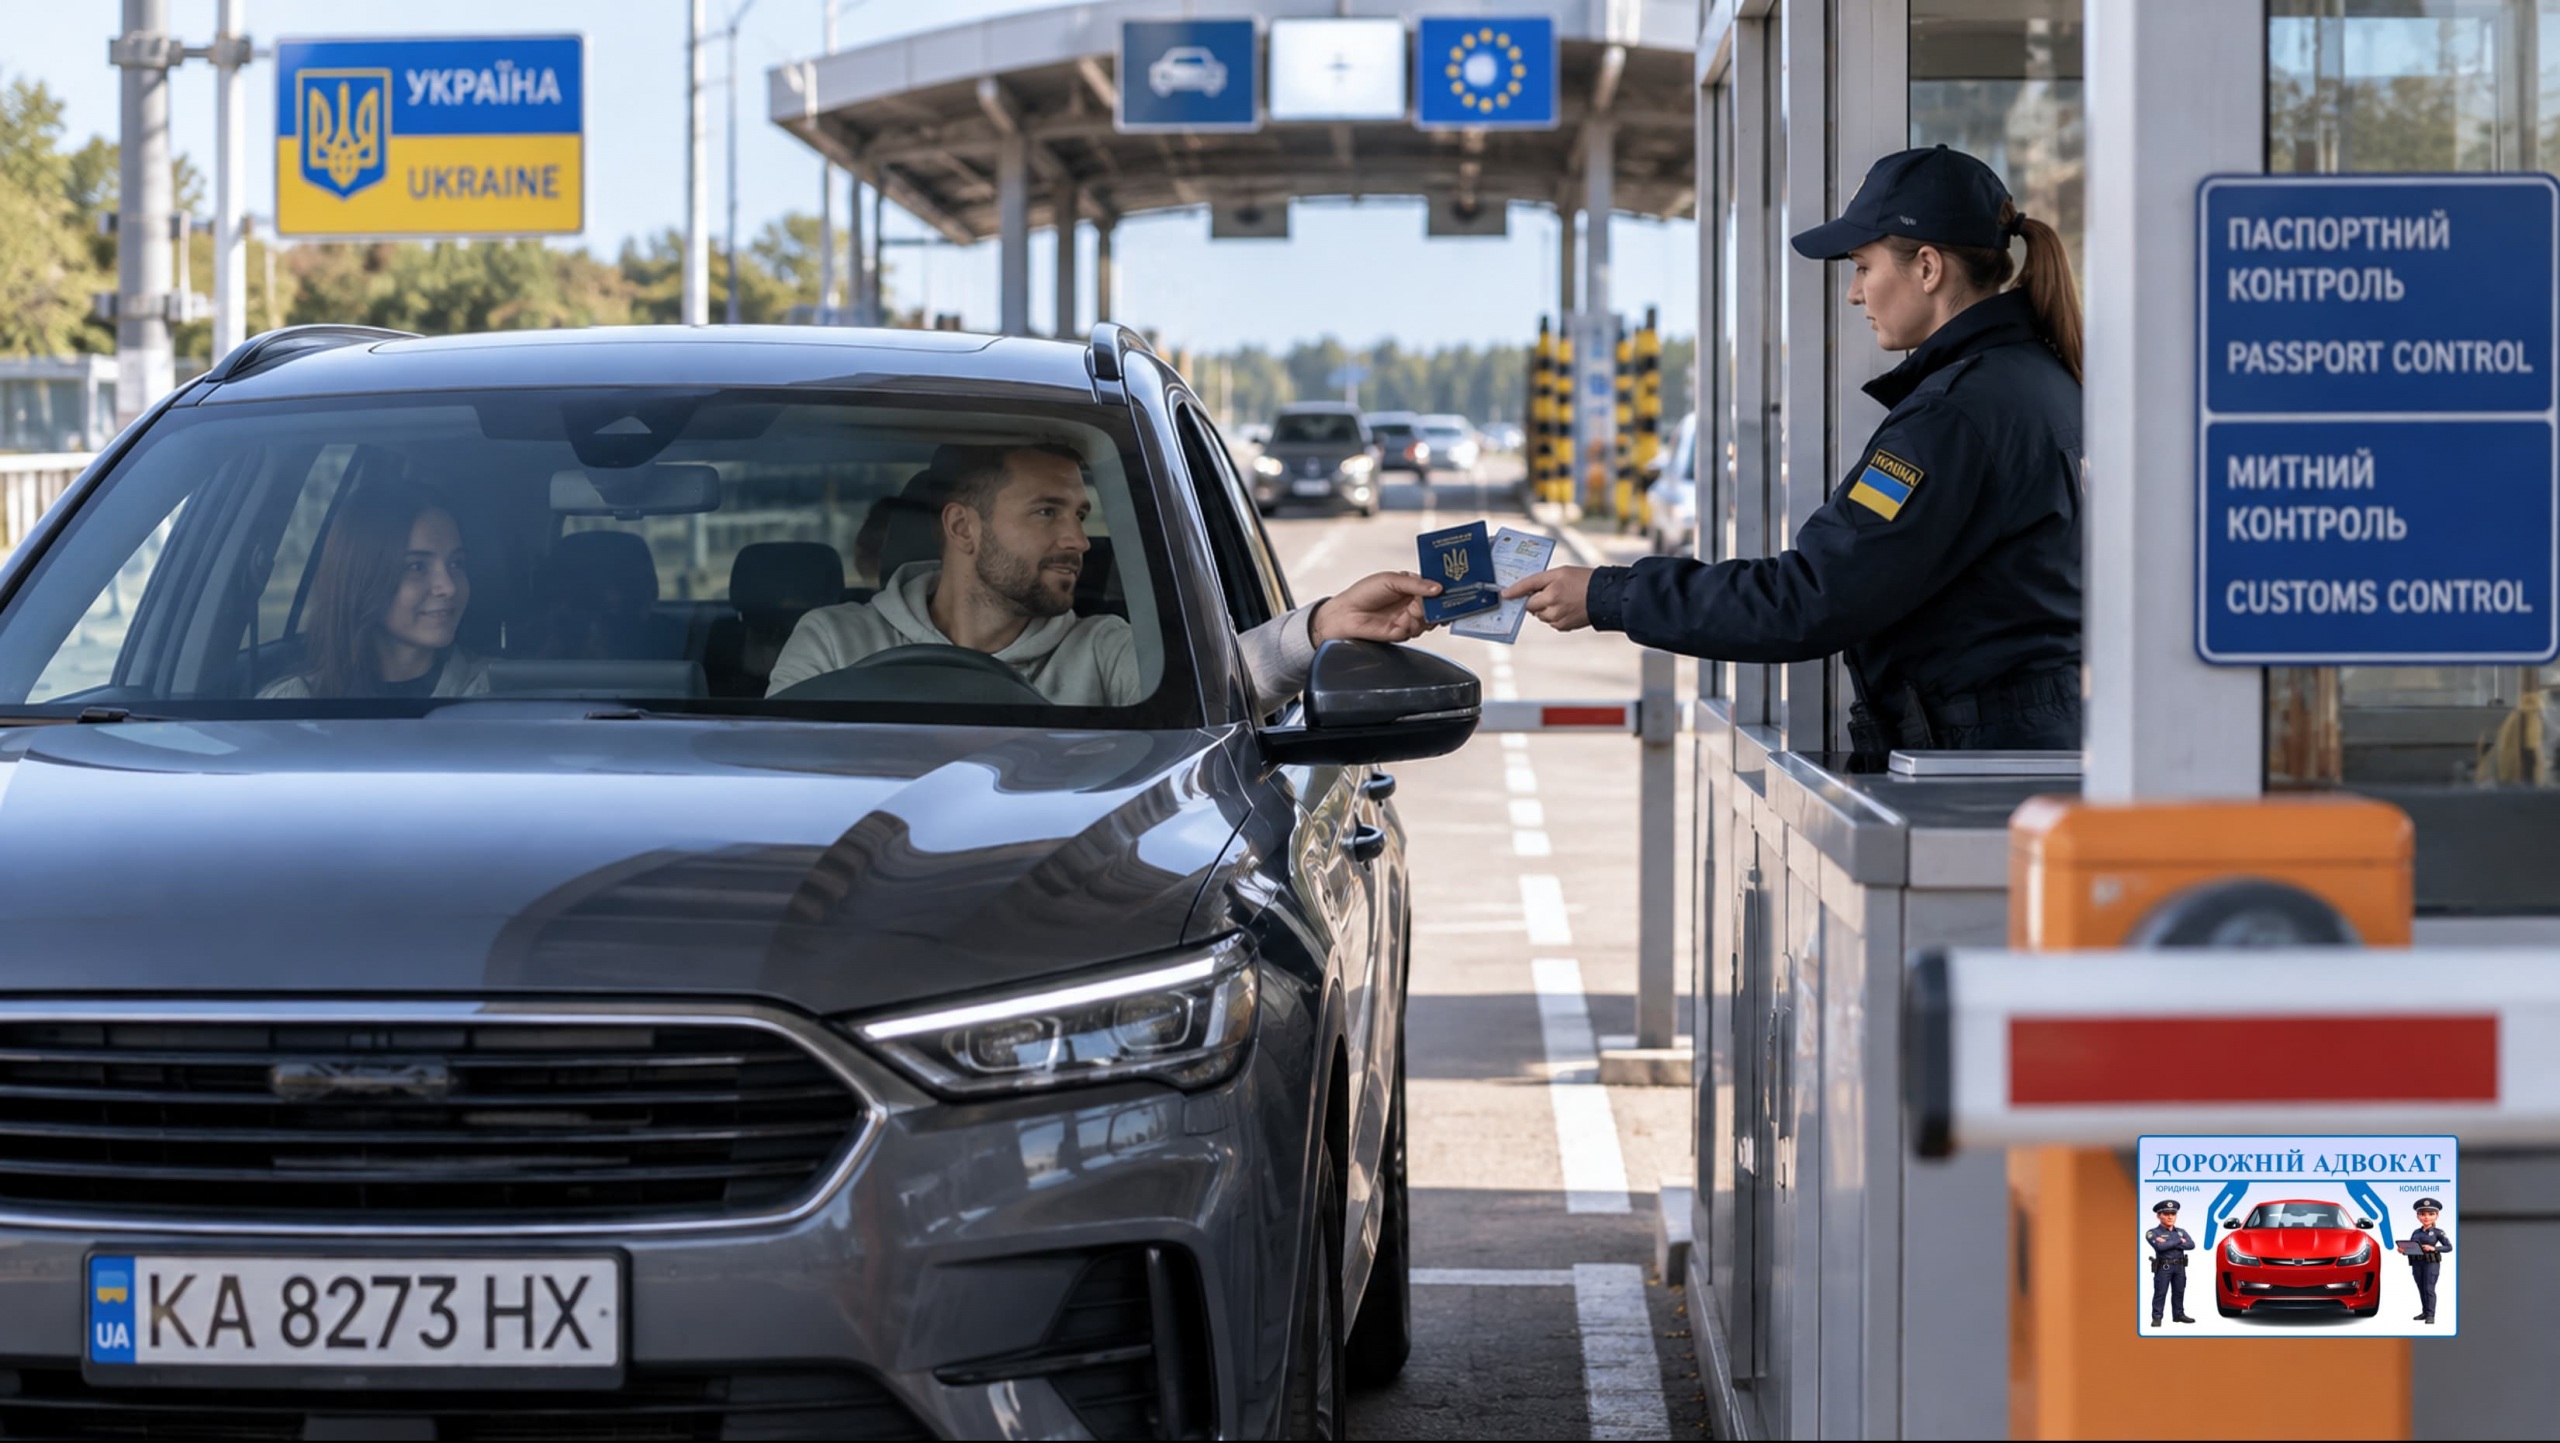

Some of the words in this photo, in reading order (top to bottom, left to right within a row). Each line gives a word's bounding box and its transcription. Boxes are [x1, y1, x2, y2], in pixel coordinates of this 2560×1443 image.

[406, 61, 561, 105] УКРАЇНА
[408, 165, 560, 200] UKRAINE
[2228, 210, 2450, 250] ПАСПОРТНИЙ
[2228, 267, 2405, 301] КОНТРОЛЬ
[2228, 341, 2384, 373] PASSPORT
[2393, 341, 2533, 373] CONTROL
[2228, 448, 2374, 489] МИТНИЙ
[2228, 506, 2407, 541] КОНТРОЛЬ
[2226, 580, 2378, 614] CUSTOMS
[2388, 580, 2532, 613] CONTROL
[280, 1275, 458, 1350] 8273
[96, 1322, 131, 1349] UA
